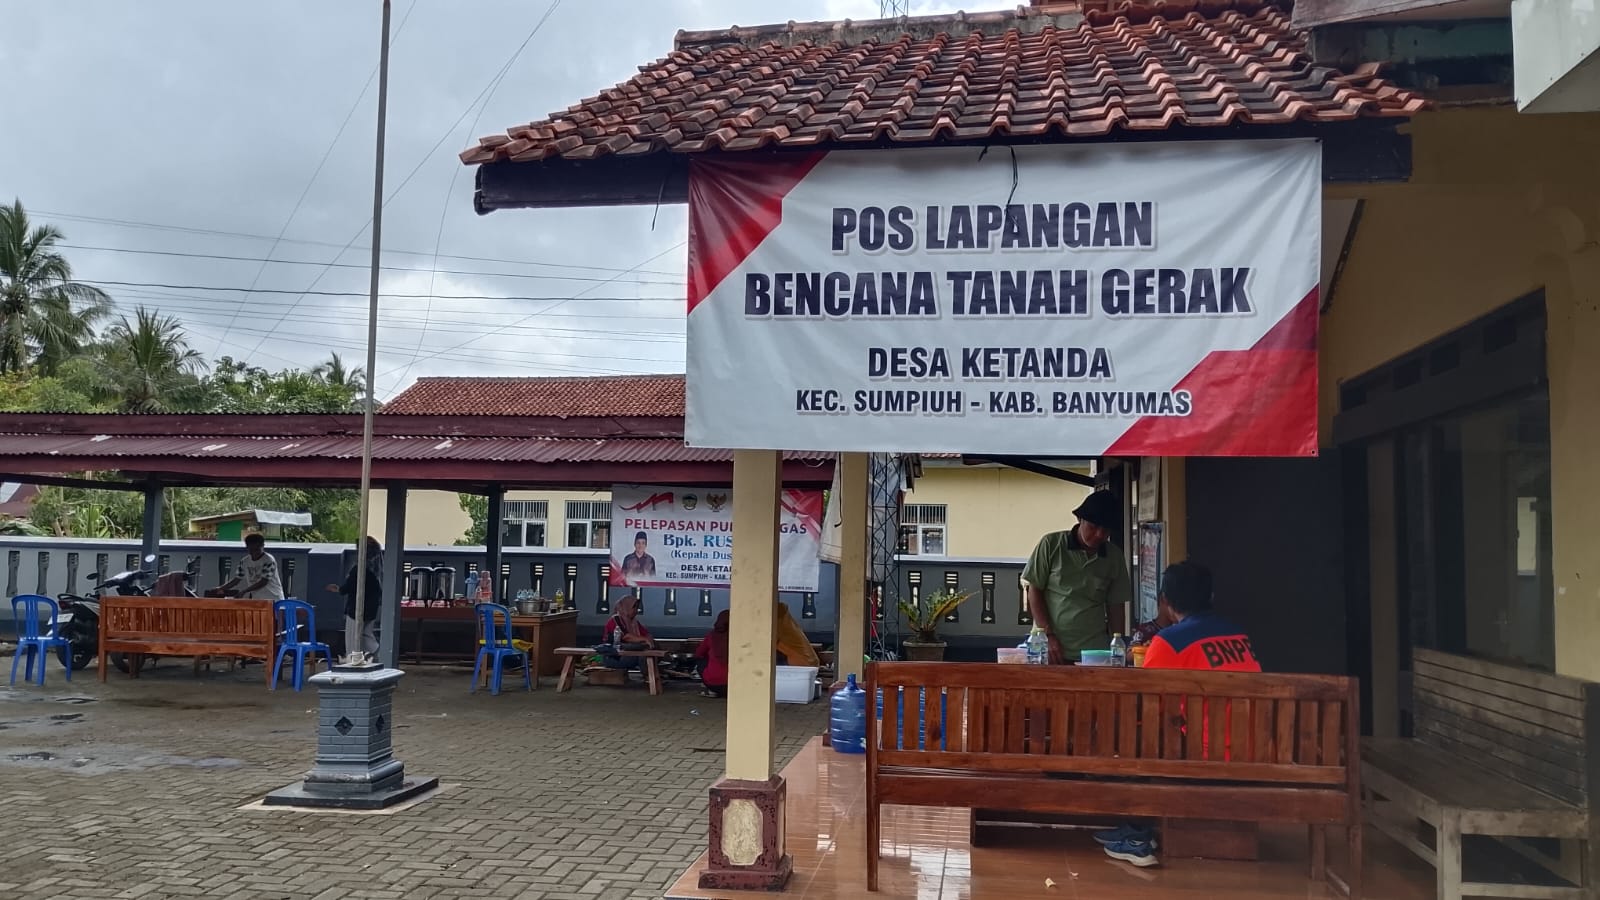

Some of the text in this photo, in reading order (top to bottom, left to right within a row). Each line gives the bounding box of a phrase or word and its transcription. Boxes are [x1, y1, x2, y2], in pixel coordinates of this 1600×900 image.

[831, 202, 1152, 251] POS LAPANGAN
[745, 267, 1251, 317] BENCANA TANAH GERAK
[868, 346, 1111, 378] DESA KETANDA
[796, 389, 846, 412] KEC.
[853, 389, 962, 413] SUMPIUH
[989, 390, 1043, 413] KAB.
[1053, 389, 1191, 415] BANYUMAS
[624, 518, 706, 532] PELEPASAN
[710, 521, 733, 532] PU
[663, 534, 697, 548] Bpk.
[671, 550, 709, 560] (Kepala
[681, 564, 732, 573] DESA KETA
